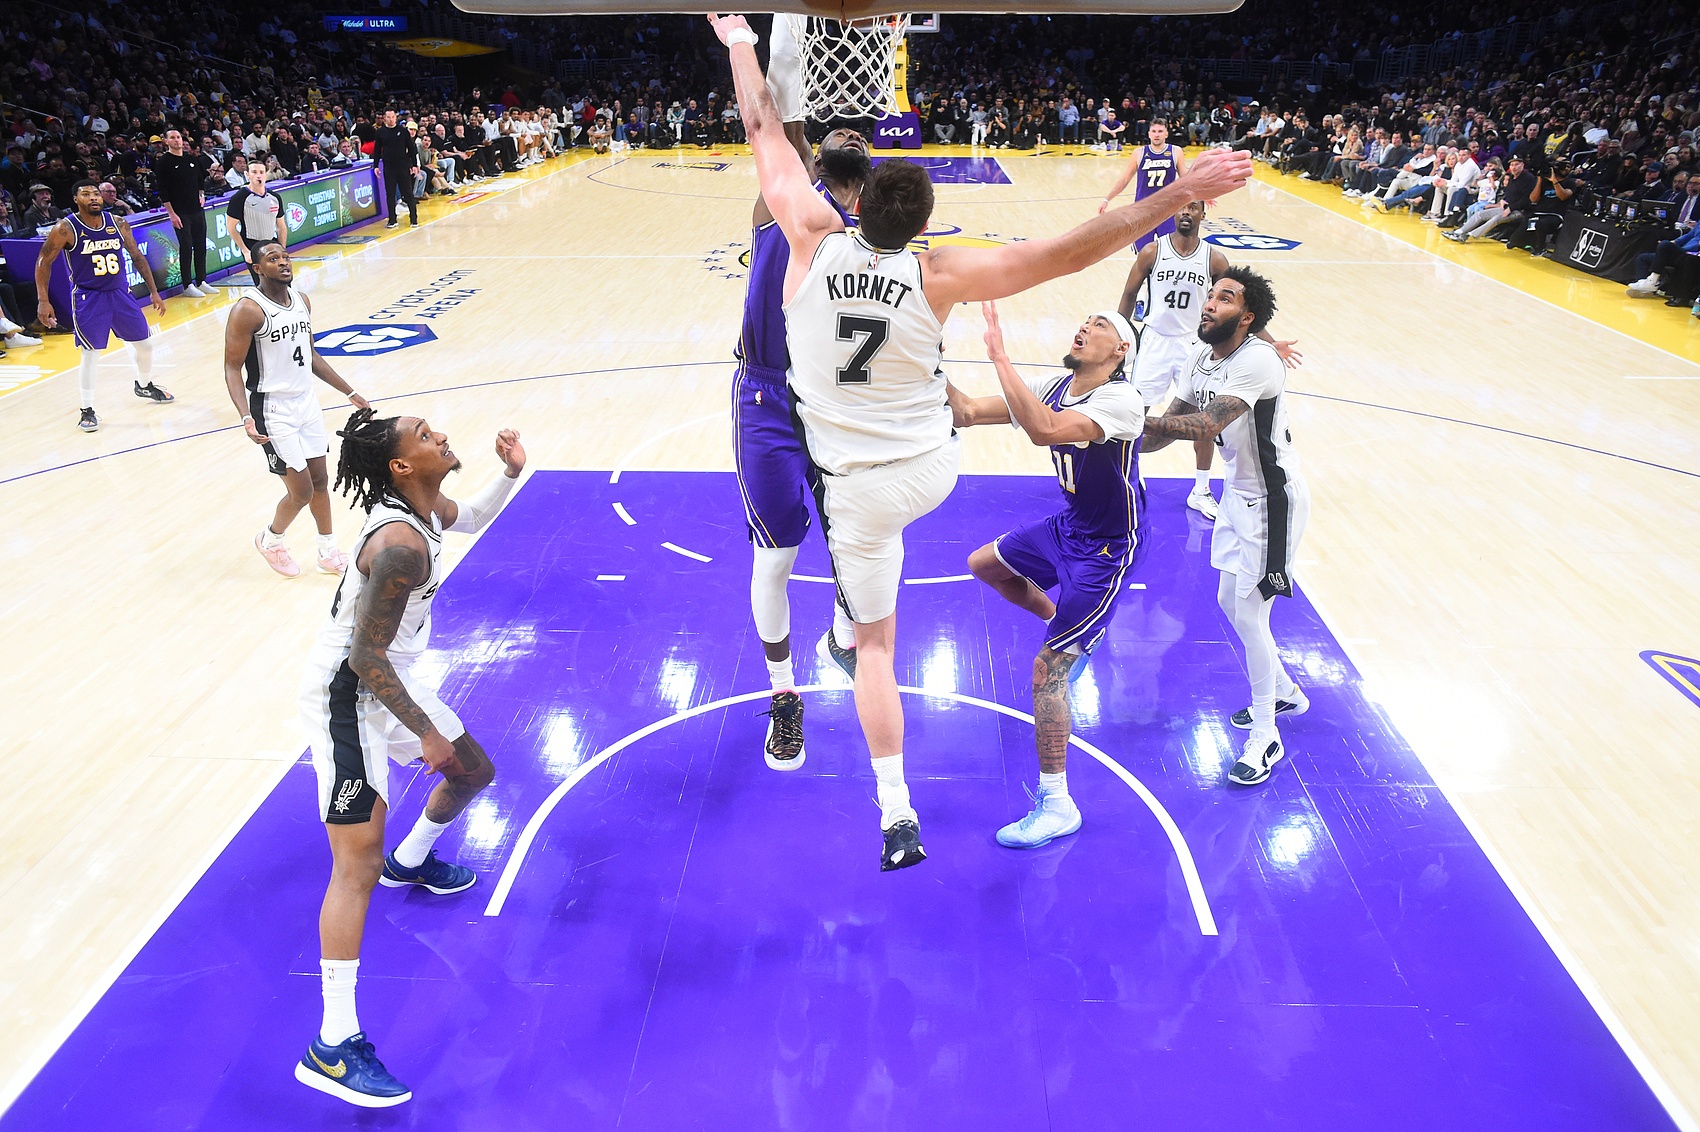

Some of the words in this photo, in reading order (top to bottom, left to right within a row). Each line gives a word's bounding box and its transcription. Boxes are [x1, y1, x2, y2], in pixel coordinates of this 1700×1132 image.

[370, 19, 395, 28] ULTRA
[1142, 158, 1171, 170] LAKERS
[1147, 169, 1167, 187] 77
[308, 188, 336, 205] CHRISTMAS
[355, 184, 373, 202] prime
[316, 200, 331, 215] NIGHT
[80, 238, 121, 254] LAKERS
[91, 253, 120, 276] 36
[1157, 269, 1205, 287] SPURS
[368, 269, 477, 319] crypto.com
[826, 273, 912, 309] KORNET
[1164, 290, 1191, 309] 40
[414, 288, 483, 319] ARENA
[292, 345, 305, 367] 4
[835, 312, 890, 386] 7
[1052, 450, 1076, 495] 11
